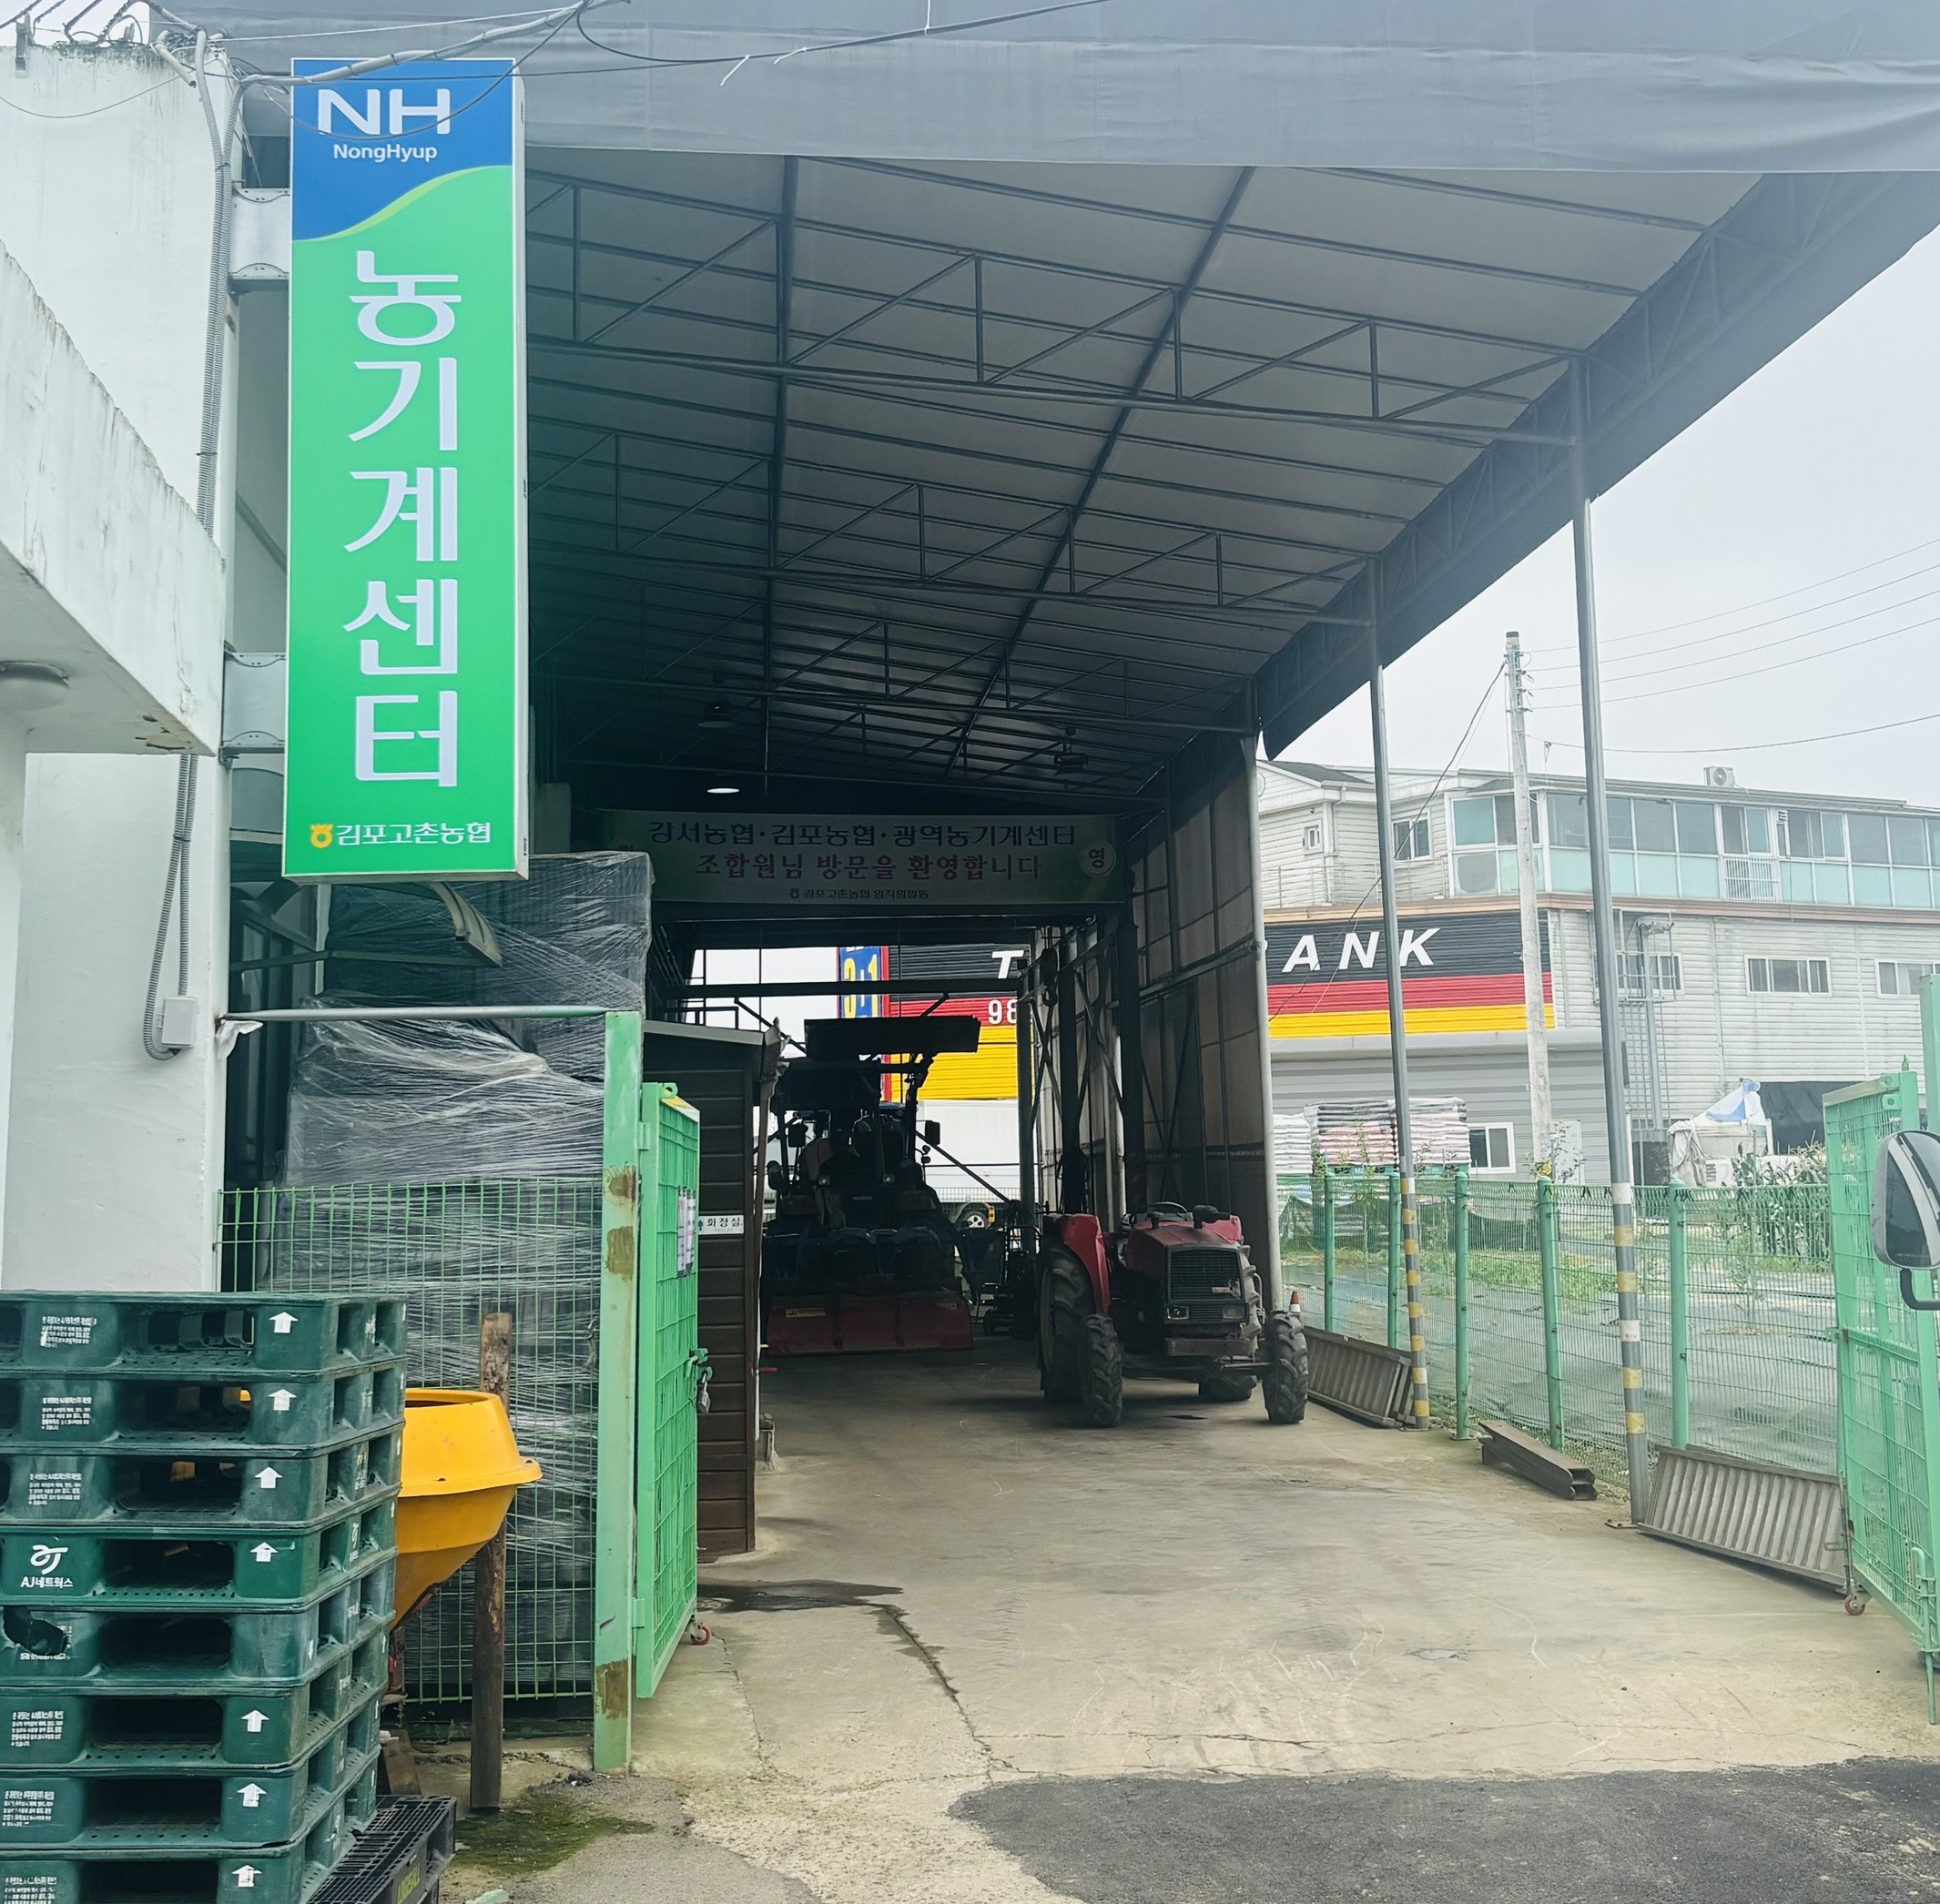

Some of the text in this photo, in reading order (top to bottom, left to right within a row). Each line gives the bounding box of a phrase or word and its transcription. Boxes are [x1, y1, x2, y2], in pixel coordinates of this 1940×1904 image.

[318, 88, 451, 136] NH
[333, 144, 438, 163] NongHyup
[342, 250, 462, 787] 농기계센터
[335, 821, 491, 846] 김포고촌농협
[696, 853, 1042, 881] 조합원님 방문을 환영합니다
[1265, 927, 1441, 973] ANK
[707, 1217, 740, 1228] 화장실
[20, 1575, 74, 1589] AJ네트웍스
